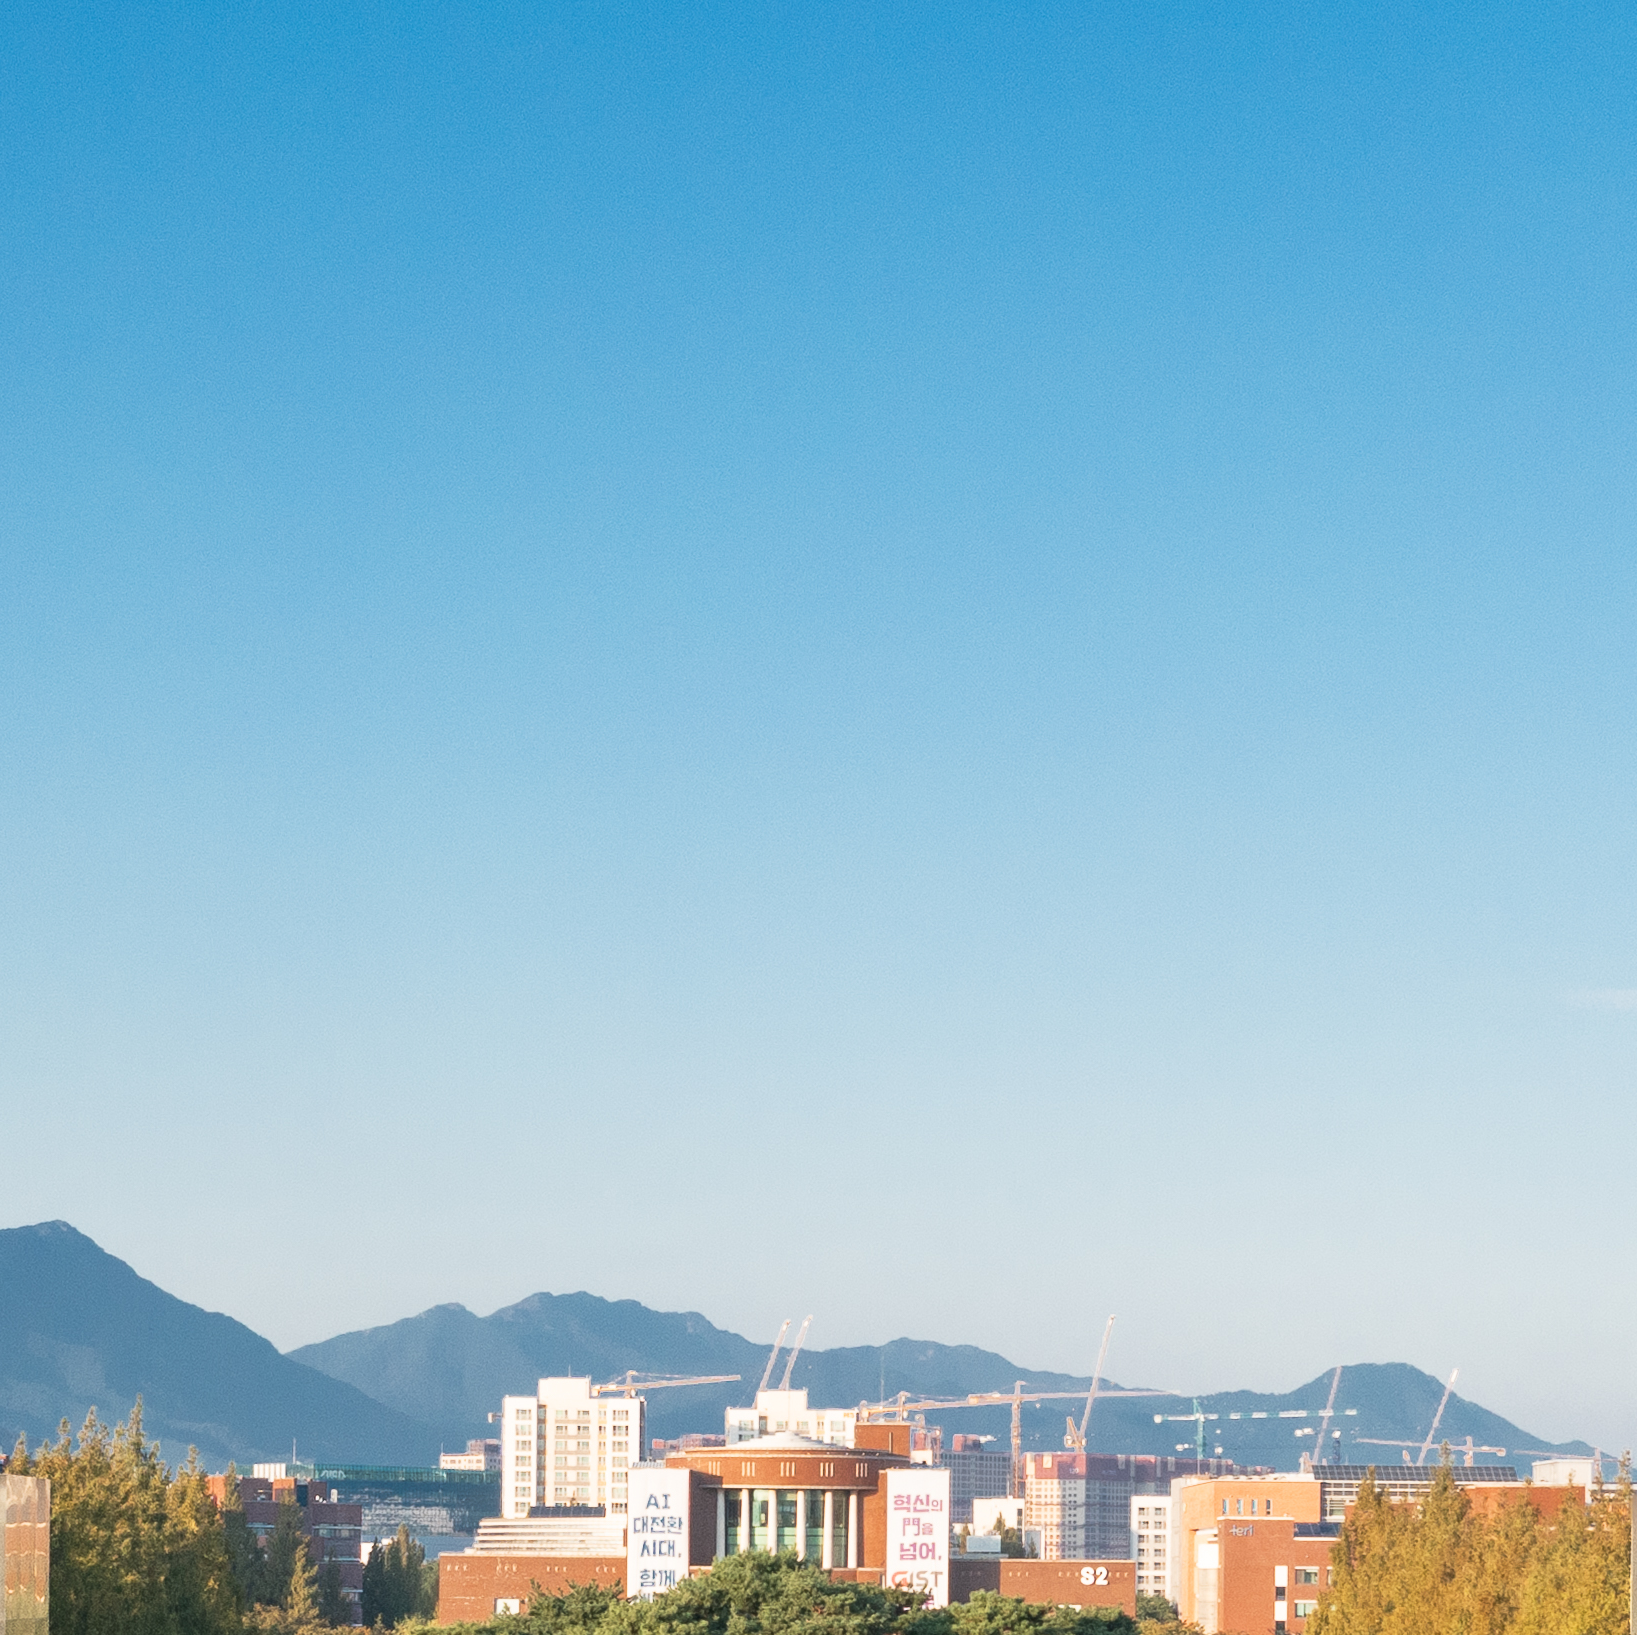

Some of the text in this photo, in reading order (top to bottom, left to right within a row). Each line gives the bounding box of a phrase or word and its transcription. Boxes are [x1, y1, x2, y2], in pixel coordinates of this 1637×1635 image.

[646, 1494, 670, 1509] AI
[893, 1494, 943, 1512] 혁신의
[633, 1516, 683, 1534] 대전환
[640, 1540, 682, 1558] 시대,
[899, 1542, 942, 1560] 넘어,
[640, 1569, 676, 1587] 함께
[891, 1570, 943, 1587] GIST
[1080, 1566, 1109, 1585] S2
